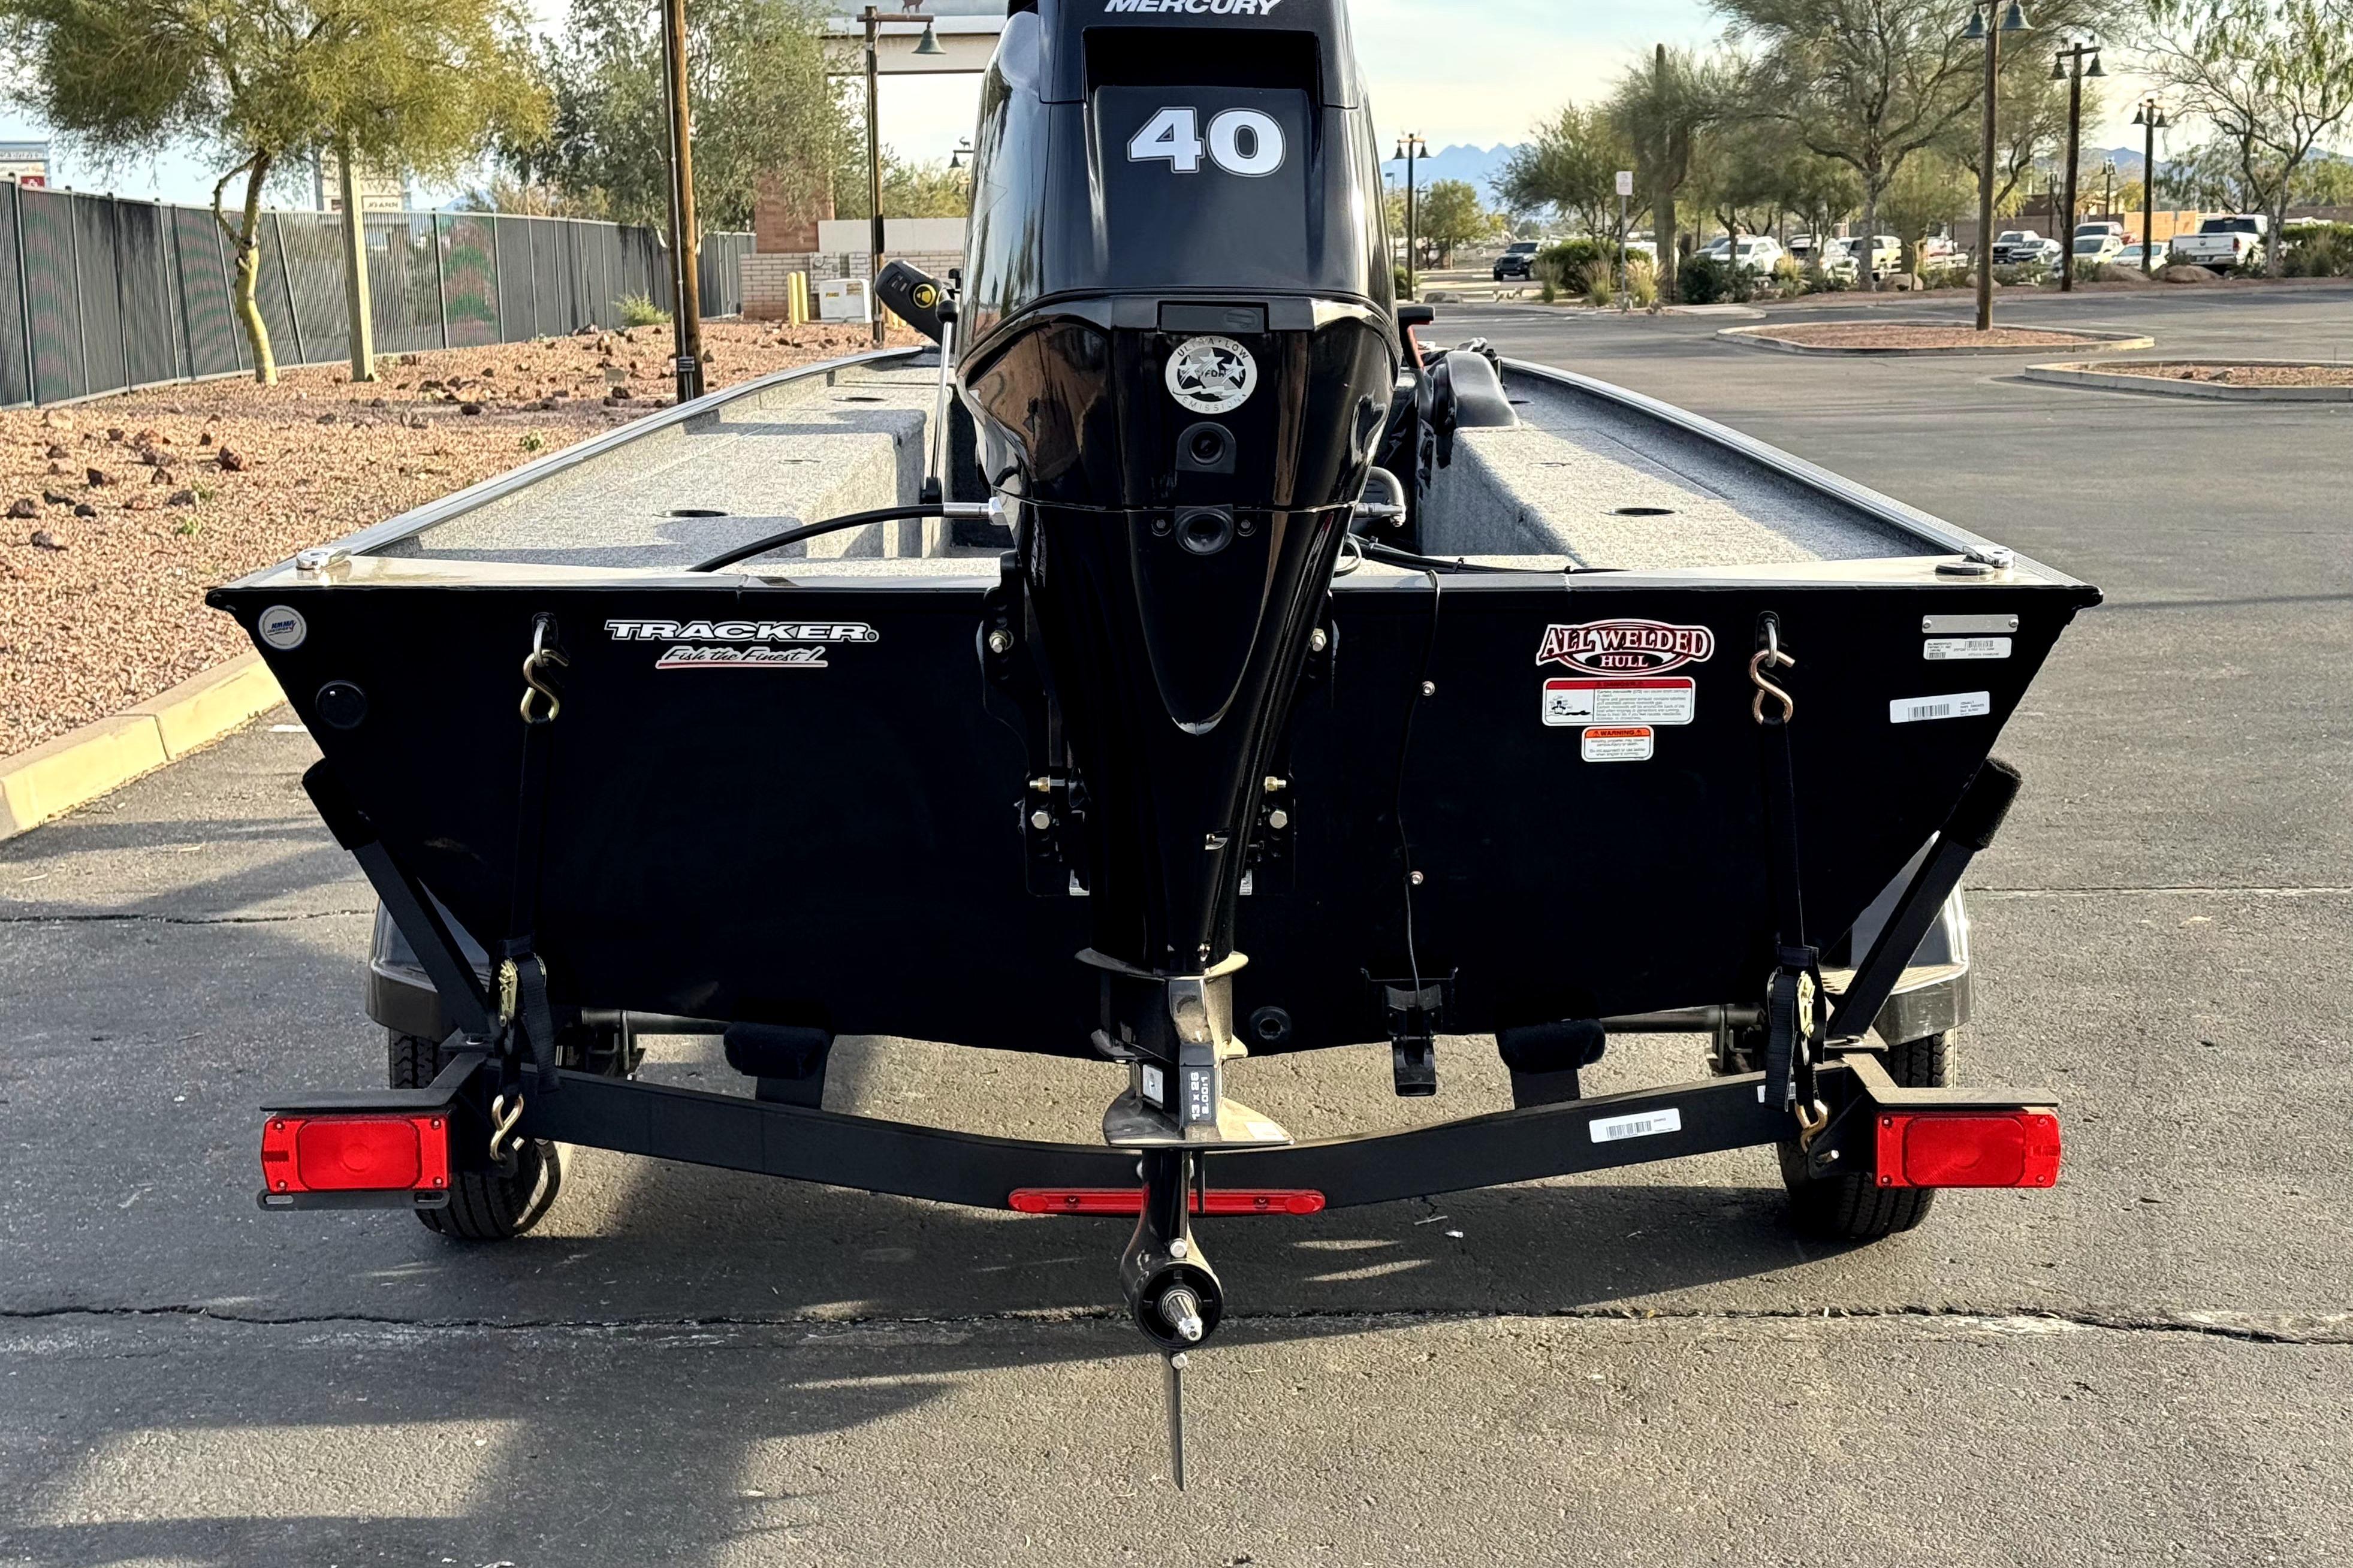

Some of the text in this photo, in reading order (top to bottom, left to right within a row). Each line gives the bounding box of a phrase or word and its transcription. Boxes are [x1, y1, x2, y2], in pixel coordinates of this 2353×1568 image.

[1104, 0, 1283, 16] MERCURY
[1128, 107, 1286, 176] 40
[1224, 339, 1250, 359] LOW
[1181, 396, 1242, 412] EMISSION
[607, 623, 870, 641] TRACKER
[1540, 628, 1709, 659] ALL WELDED
[663, 648, 708, 662] Fish
[709, 649, 738, 661] the
[1600, 654, 1648, 667] HULL
[1191, 1104, 1200, 1120] 13
